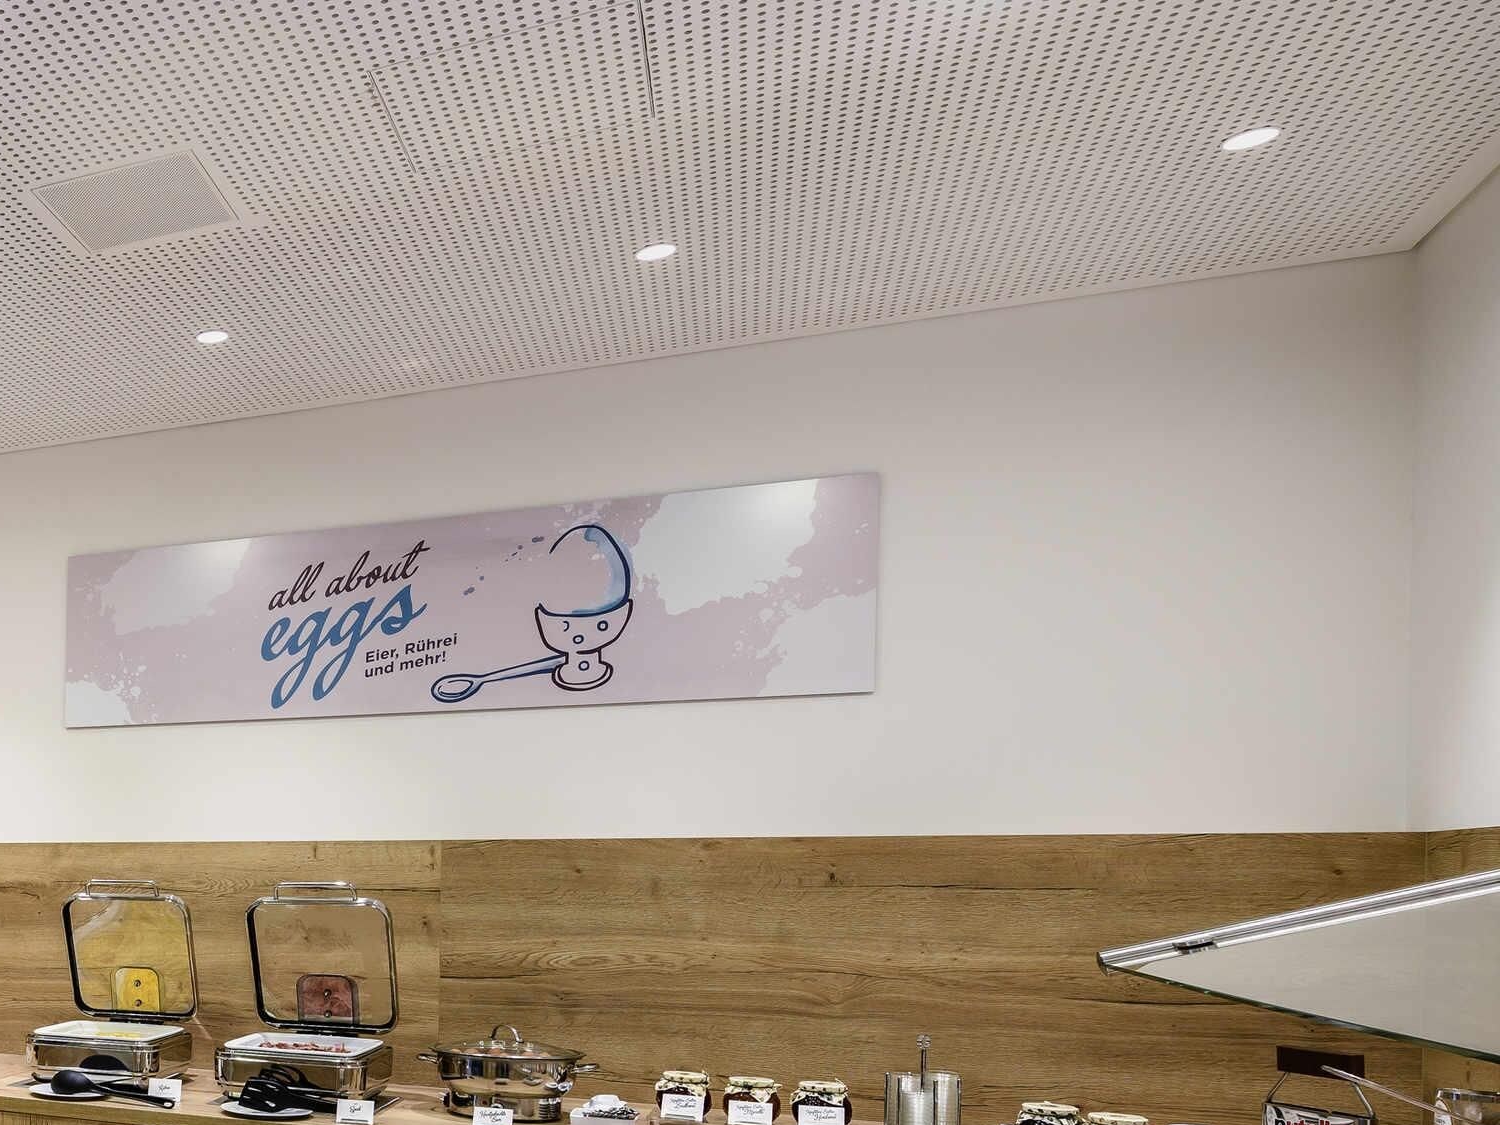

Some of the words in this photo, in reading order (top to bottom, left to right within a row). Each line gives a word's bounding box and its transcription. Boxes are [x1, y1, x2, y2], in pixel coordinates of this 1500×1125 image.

[268, 561, 324, 610] all
[325, 540, 430, 598] about
[261, 584, 428, 709] eggs
[364, 662, 394, 678] und
[399, 651, 446, 671] mehr!
[365, 647, 399, 663] Eier,
[405, 633, 458, 655] Rührei
